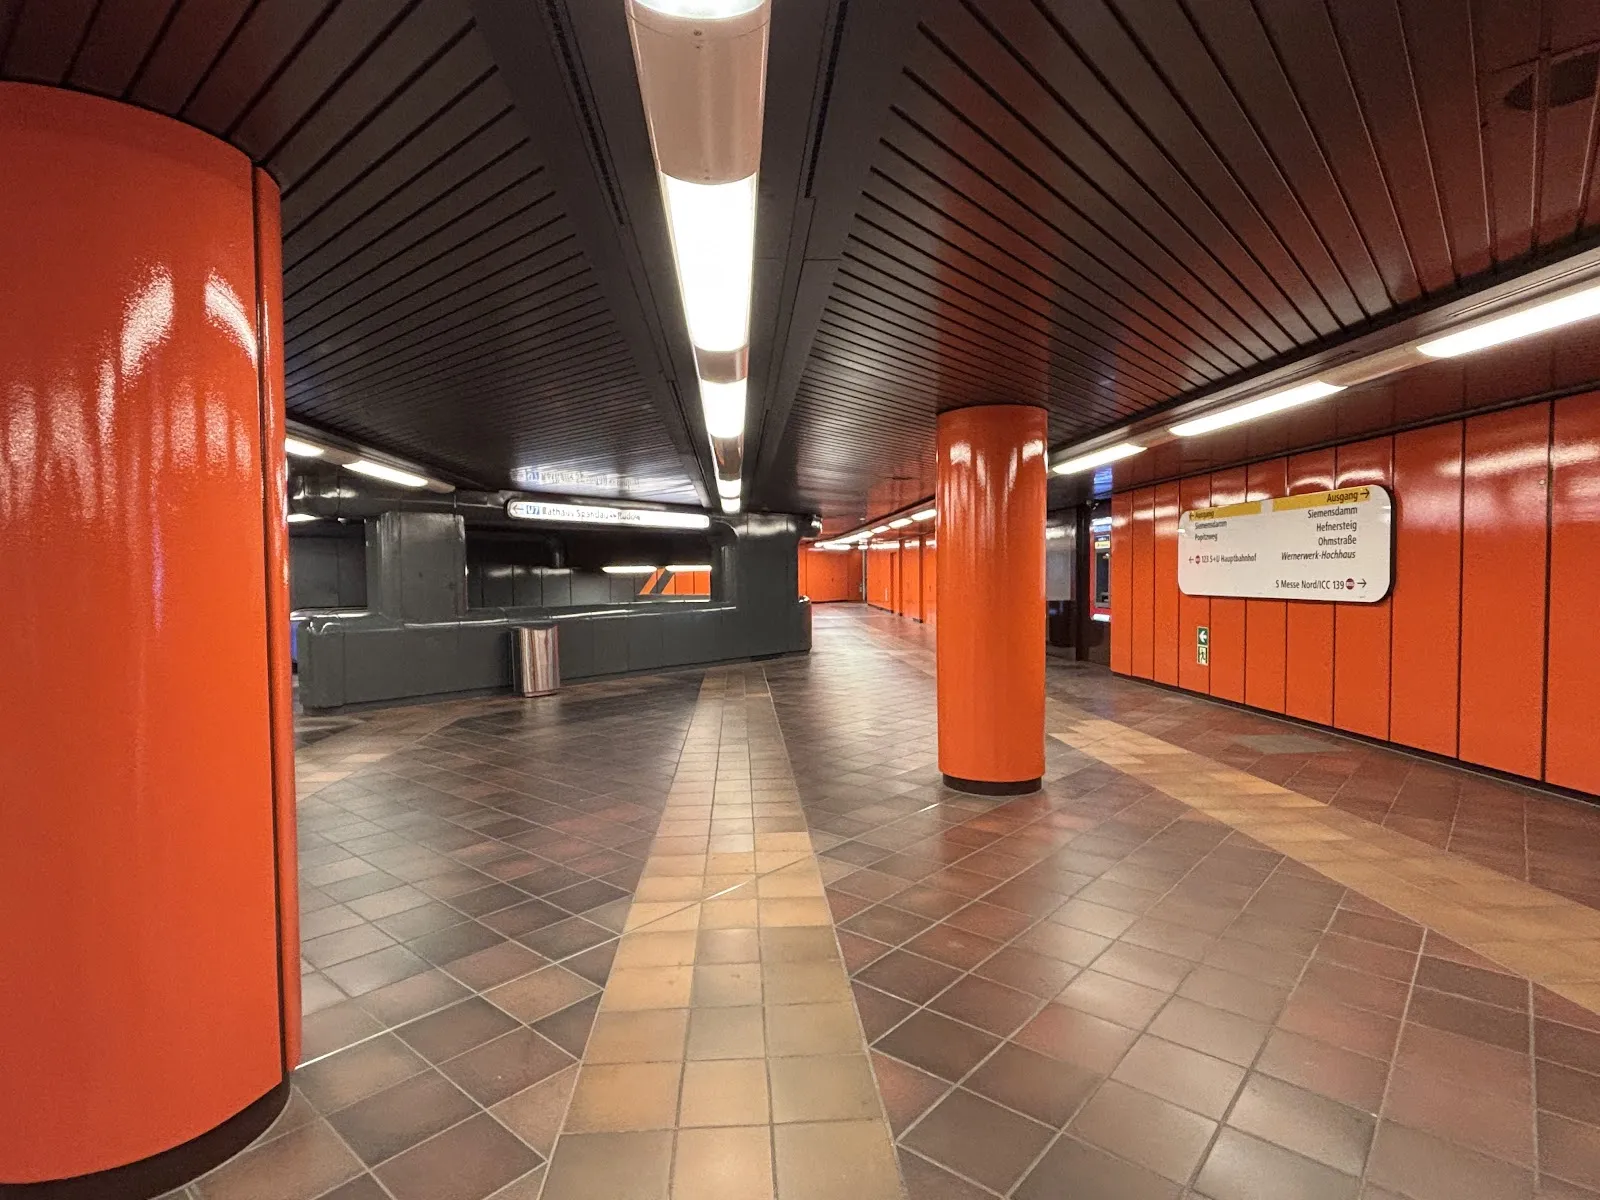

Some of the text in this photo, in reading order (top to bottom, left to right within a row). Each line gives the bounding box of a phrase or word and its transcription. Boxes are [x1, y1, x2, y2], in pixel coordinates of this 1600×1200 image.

[1326, 491, 1359, 503] Ausgang
[1195, 511, 1214, 519] Ausgang
[1308, 506, 1358, 518] Siemensdamm
[1195, 521, 1227, 529] Siemensdamm
[1316, 520, 1358, 532] Hefnersteig
[1195, 533, 1218, 542] Popitzweg
[1318, 534, 1357, 546] Ohmstraße
[1201, 555, 1209, 563] 123
[1220, 553, 1257, 564] Hauptbahnhof
[1281, 549, 1356, 561] Wernerwerk-Hochhaus
[1281, 580, 1300, 589] Messe
[1301, 580, 1331, 590] Nord/ICC
[1332, 580, 1345, 590] 139
